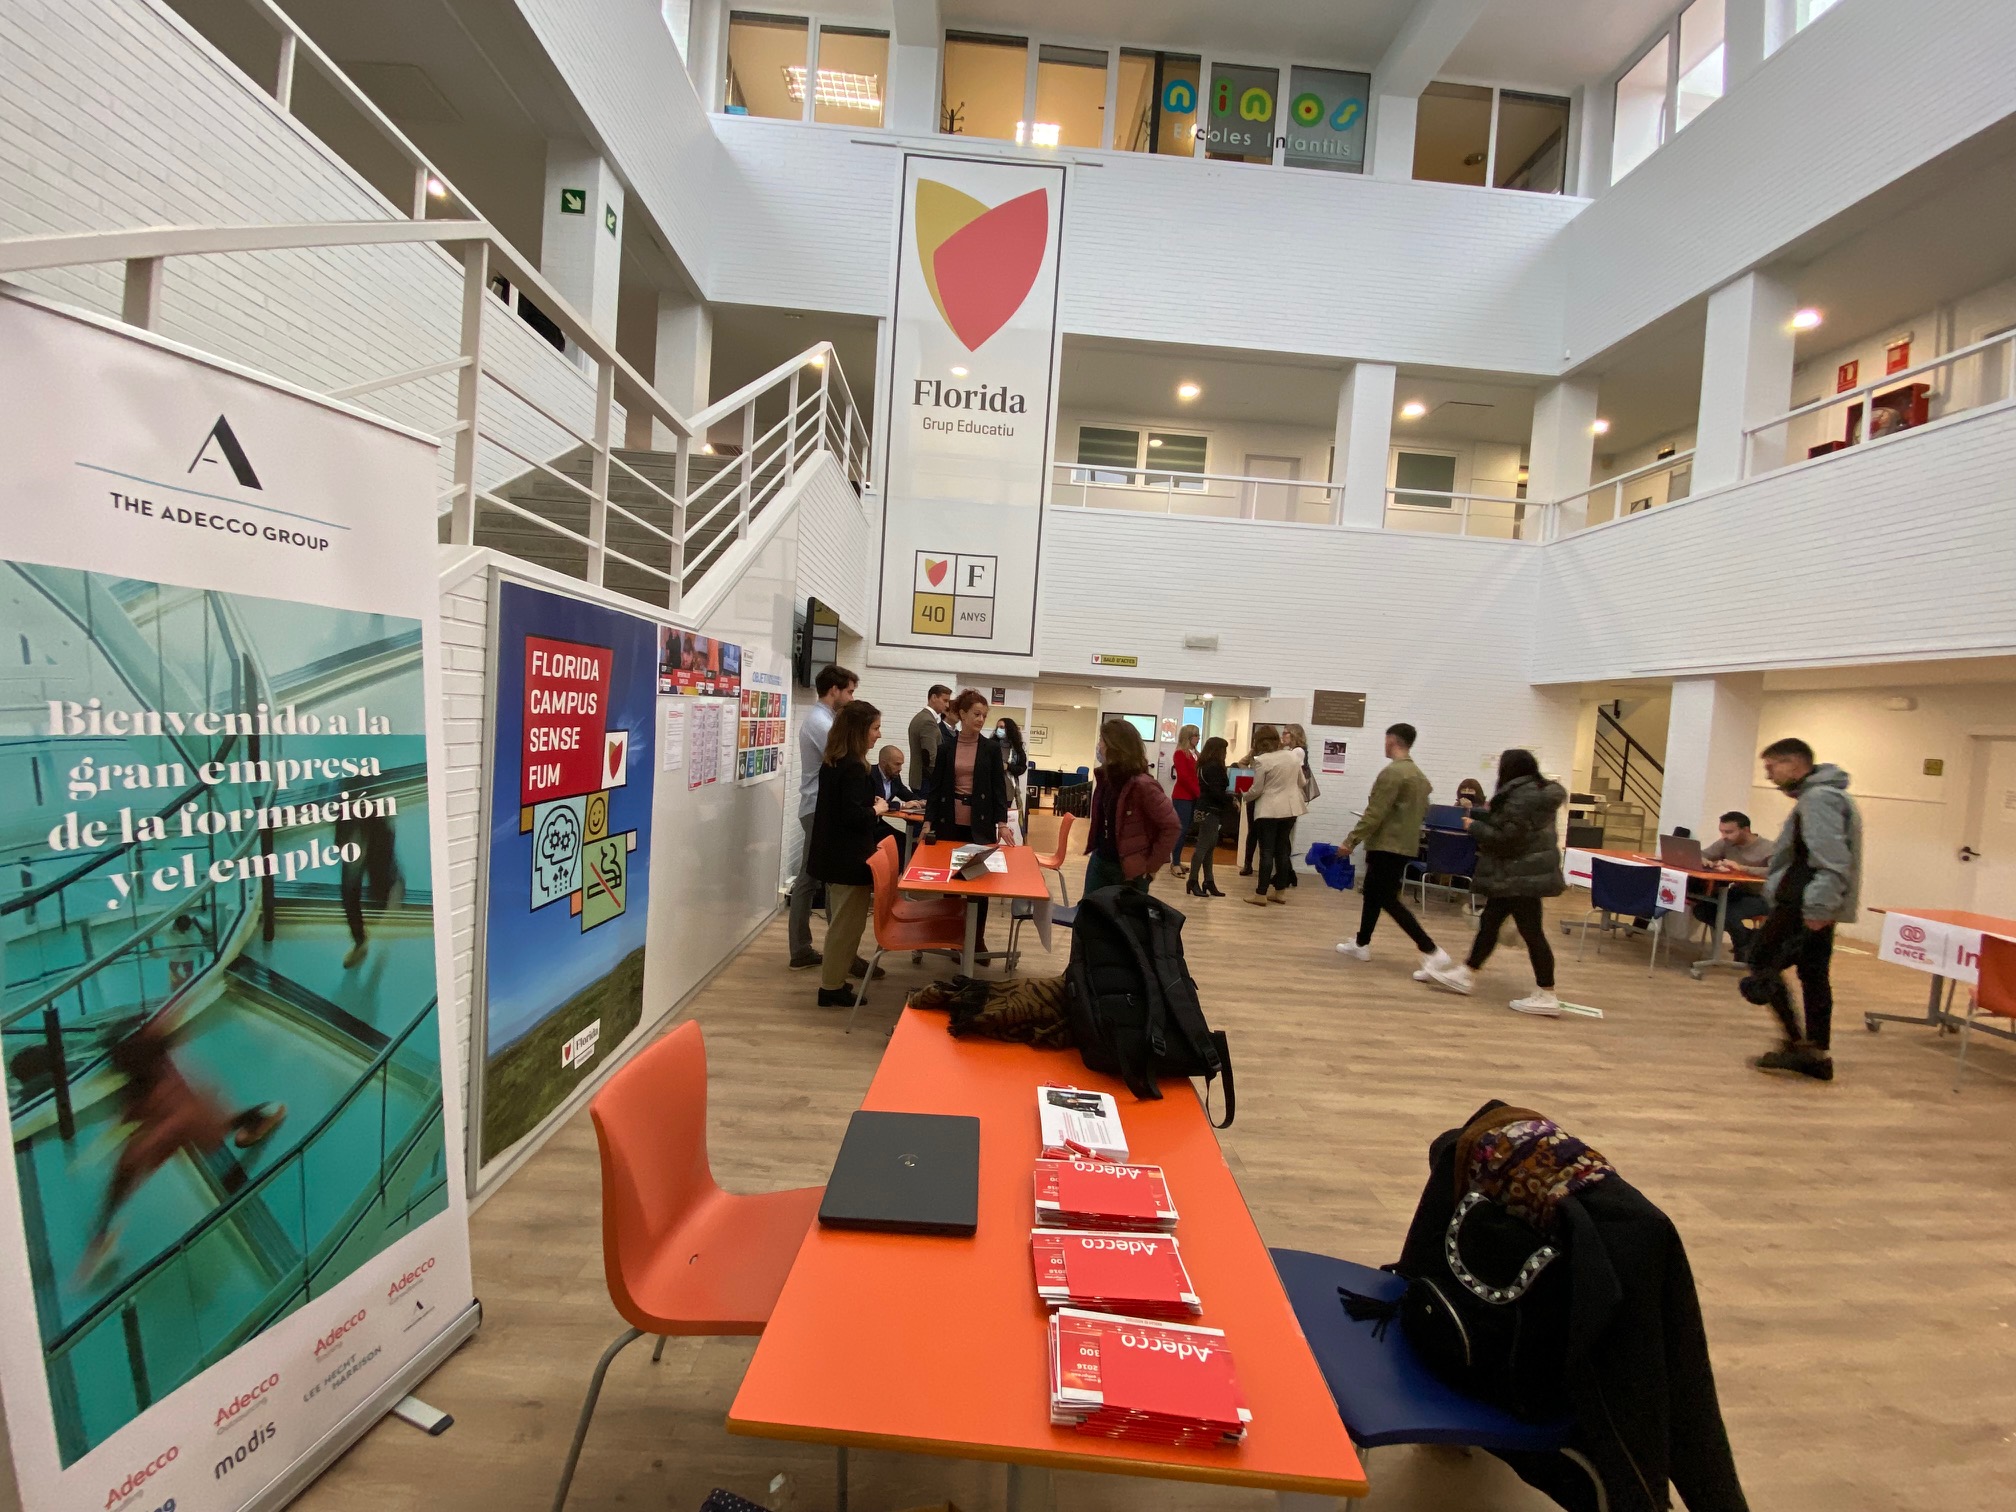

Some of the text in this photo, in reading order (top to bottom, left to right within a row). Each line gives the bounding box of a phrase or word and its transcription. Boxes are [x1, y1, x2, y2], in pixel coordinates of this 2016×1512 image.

[1173, 122, 1350, 157] Escoles Infantils
[912, 378, 1028, 414] Florida
[922, 417, 1015, 437] Grup Educatiu
[110, 492, 330, 552] THE ADECCO GROUP
[967, 564, 985, 588] F
[922, 605, 986, 623] 40 ANYS
[531, 650, 600, 682] FLORIDA
[48, 697, 391, 737] Bienvenido a la
[530, 689, 597, 716] CAMPUS
[528, 726, 581, 753] SENSE
[68, 754, 382, 801] gran empresa
[528, 763, 561, 791] FUM
[49, 790, 398, 852] de la formación
[107, 839, 362, 910] y el empleo
[1893, 947, 1926, 961] ONCE
[1957, 945, 1980, 969] In
[576, 1028, 599, 1050] Florida
[1074, 1162, 1141, 1180] Adecco
[1082, 1238, 1158, 1255] Adecco
[388, 1257, 435, 1297] Adecco
[313, 1308, 367, 1357] Adecco
[1121, 1334, 1213, 1363] Adecco
[331, 1345, 382, 1391] HARRISON
[1076, 1363, 1099, 1371] 2016
[1080, 1347, 1100, 1357] 300
[303, 1353, 358, 1403] LEE HECHT
[213, 1371, 280, 1427] Adecco
[215, 1420, 277, 1480] modis
[104, 1446, 179, 1511] Adecco
